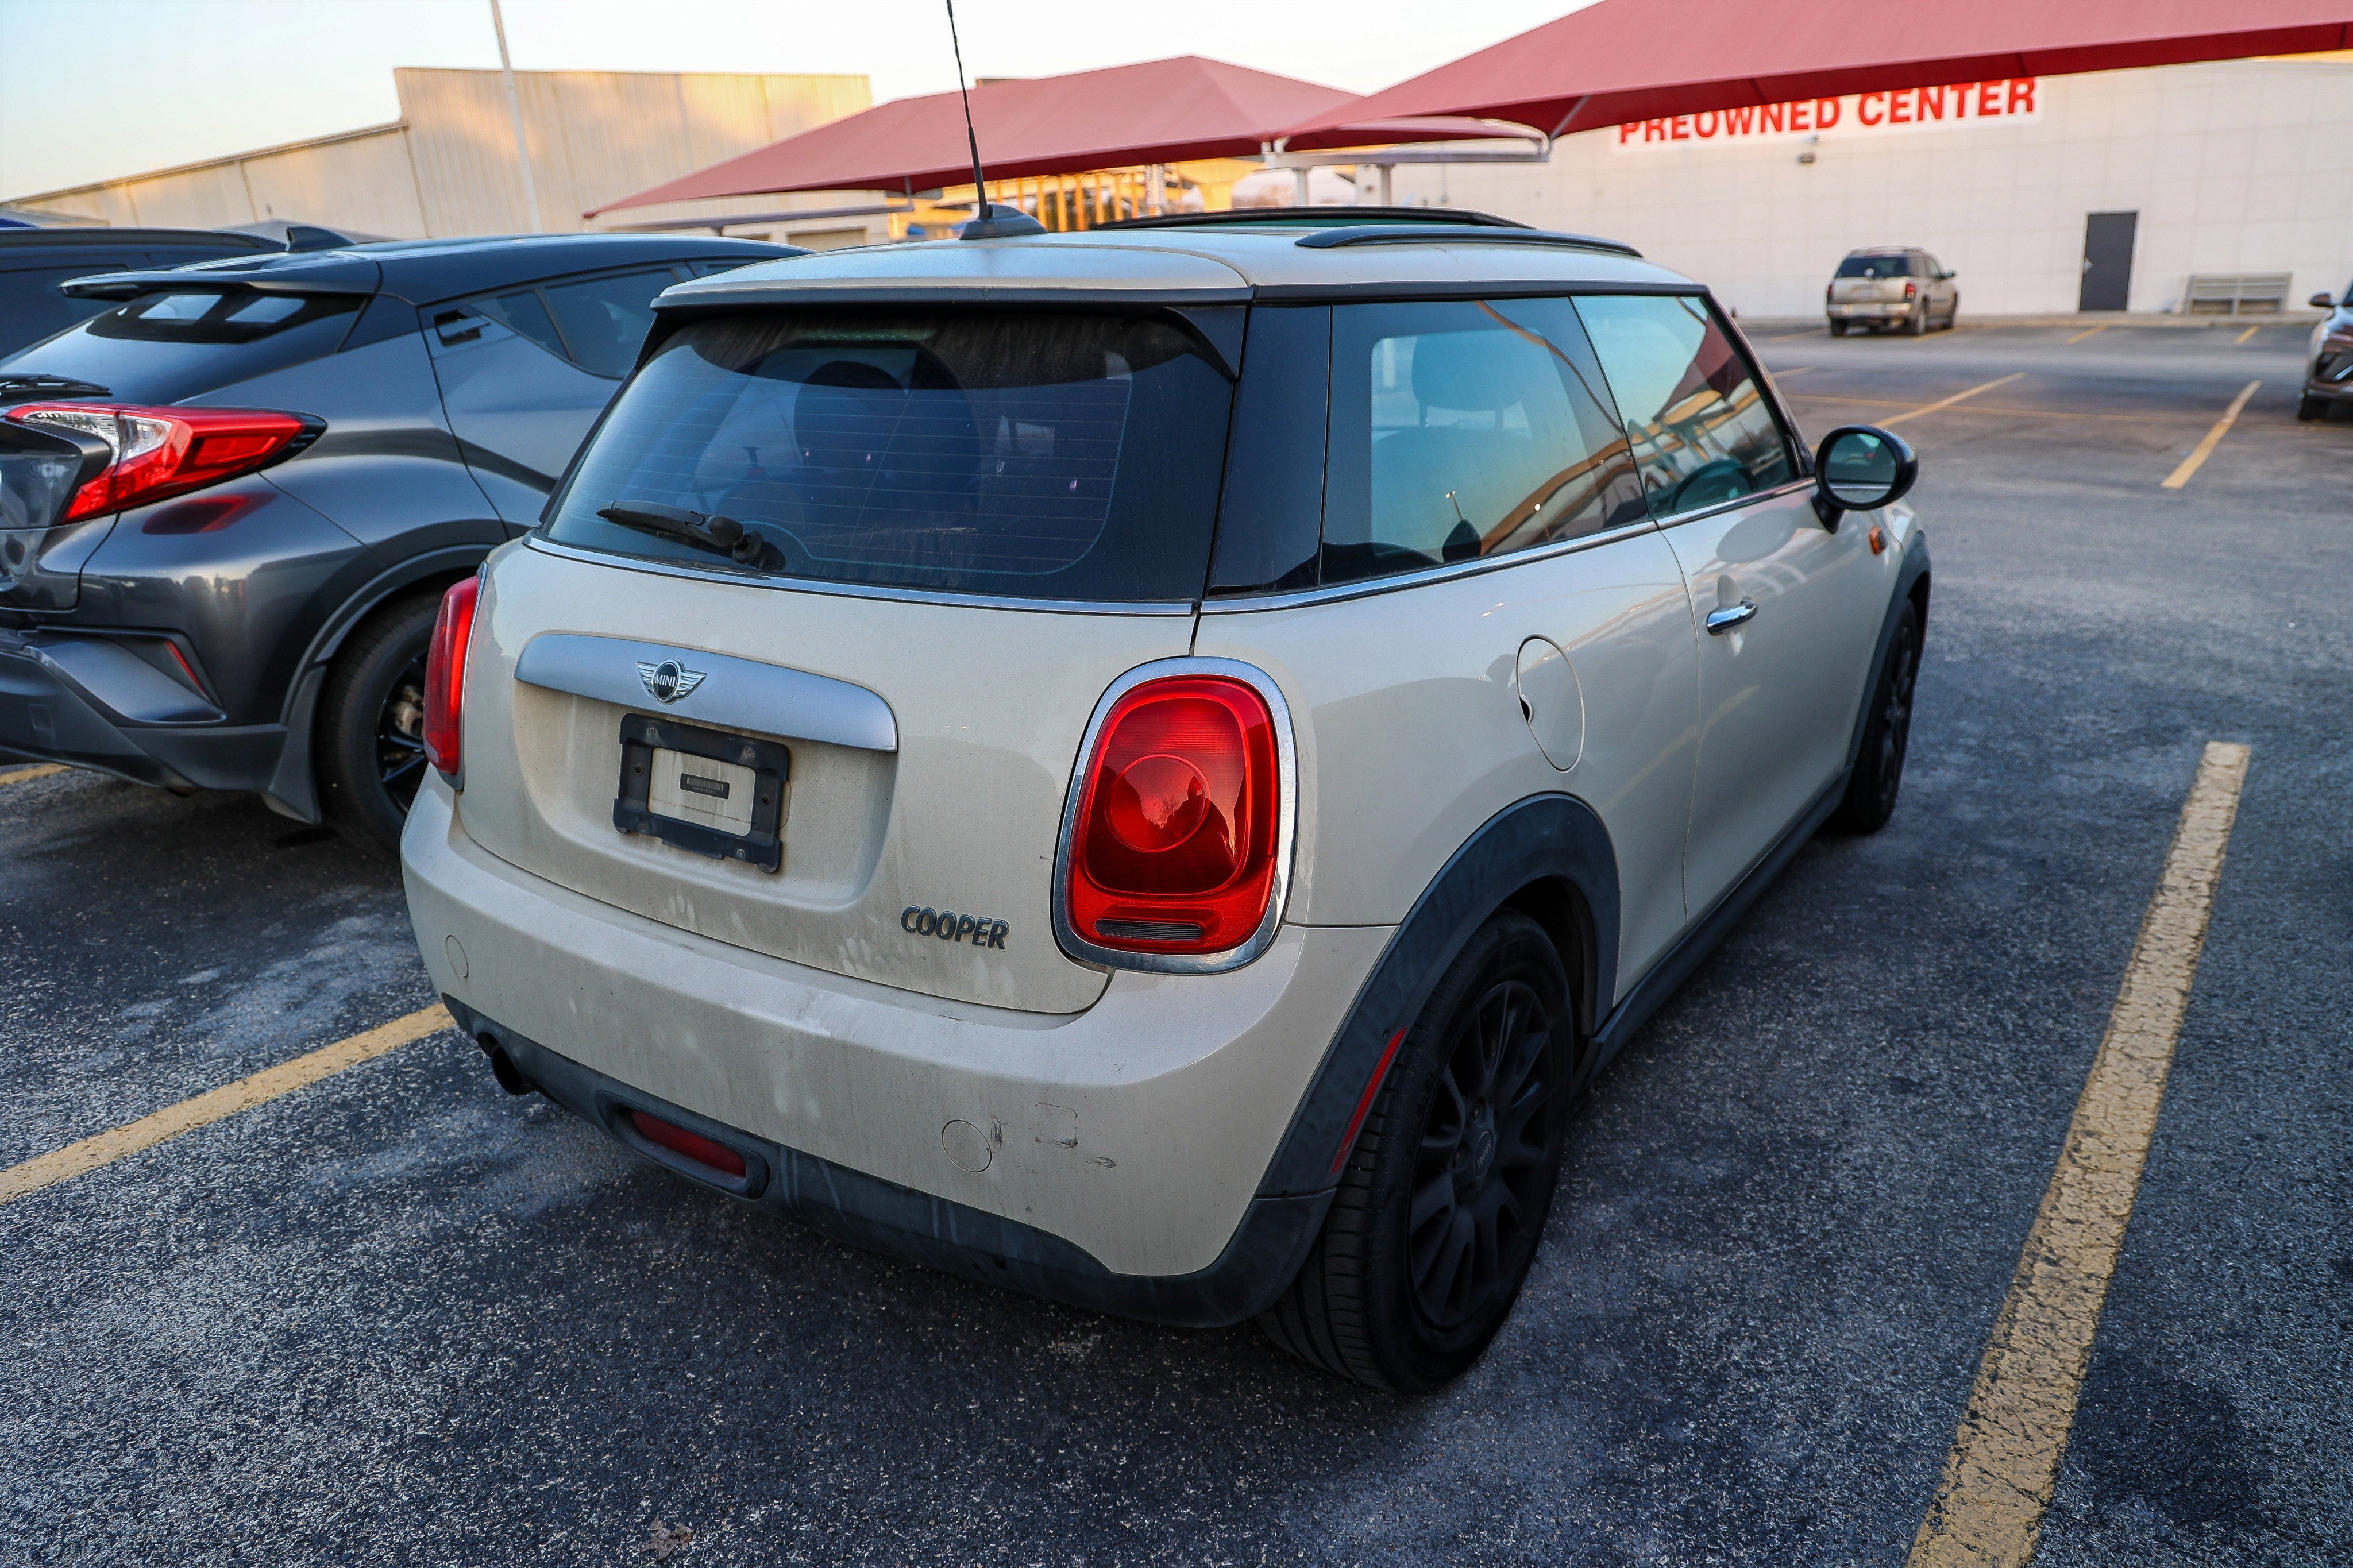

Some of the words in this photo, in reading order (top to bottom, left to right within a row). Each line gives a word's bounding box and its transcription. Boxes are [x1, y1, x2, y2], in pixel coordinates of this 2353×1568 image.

[1619, 96, 1840, 144] PREOWNED
[1858, 77, 2035, 126] CENTER
[654, 674, 676, 688] MINI
[901, 905, 1010, 951] COOPER
[1478, 1140, 1491, 1168] MINI
